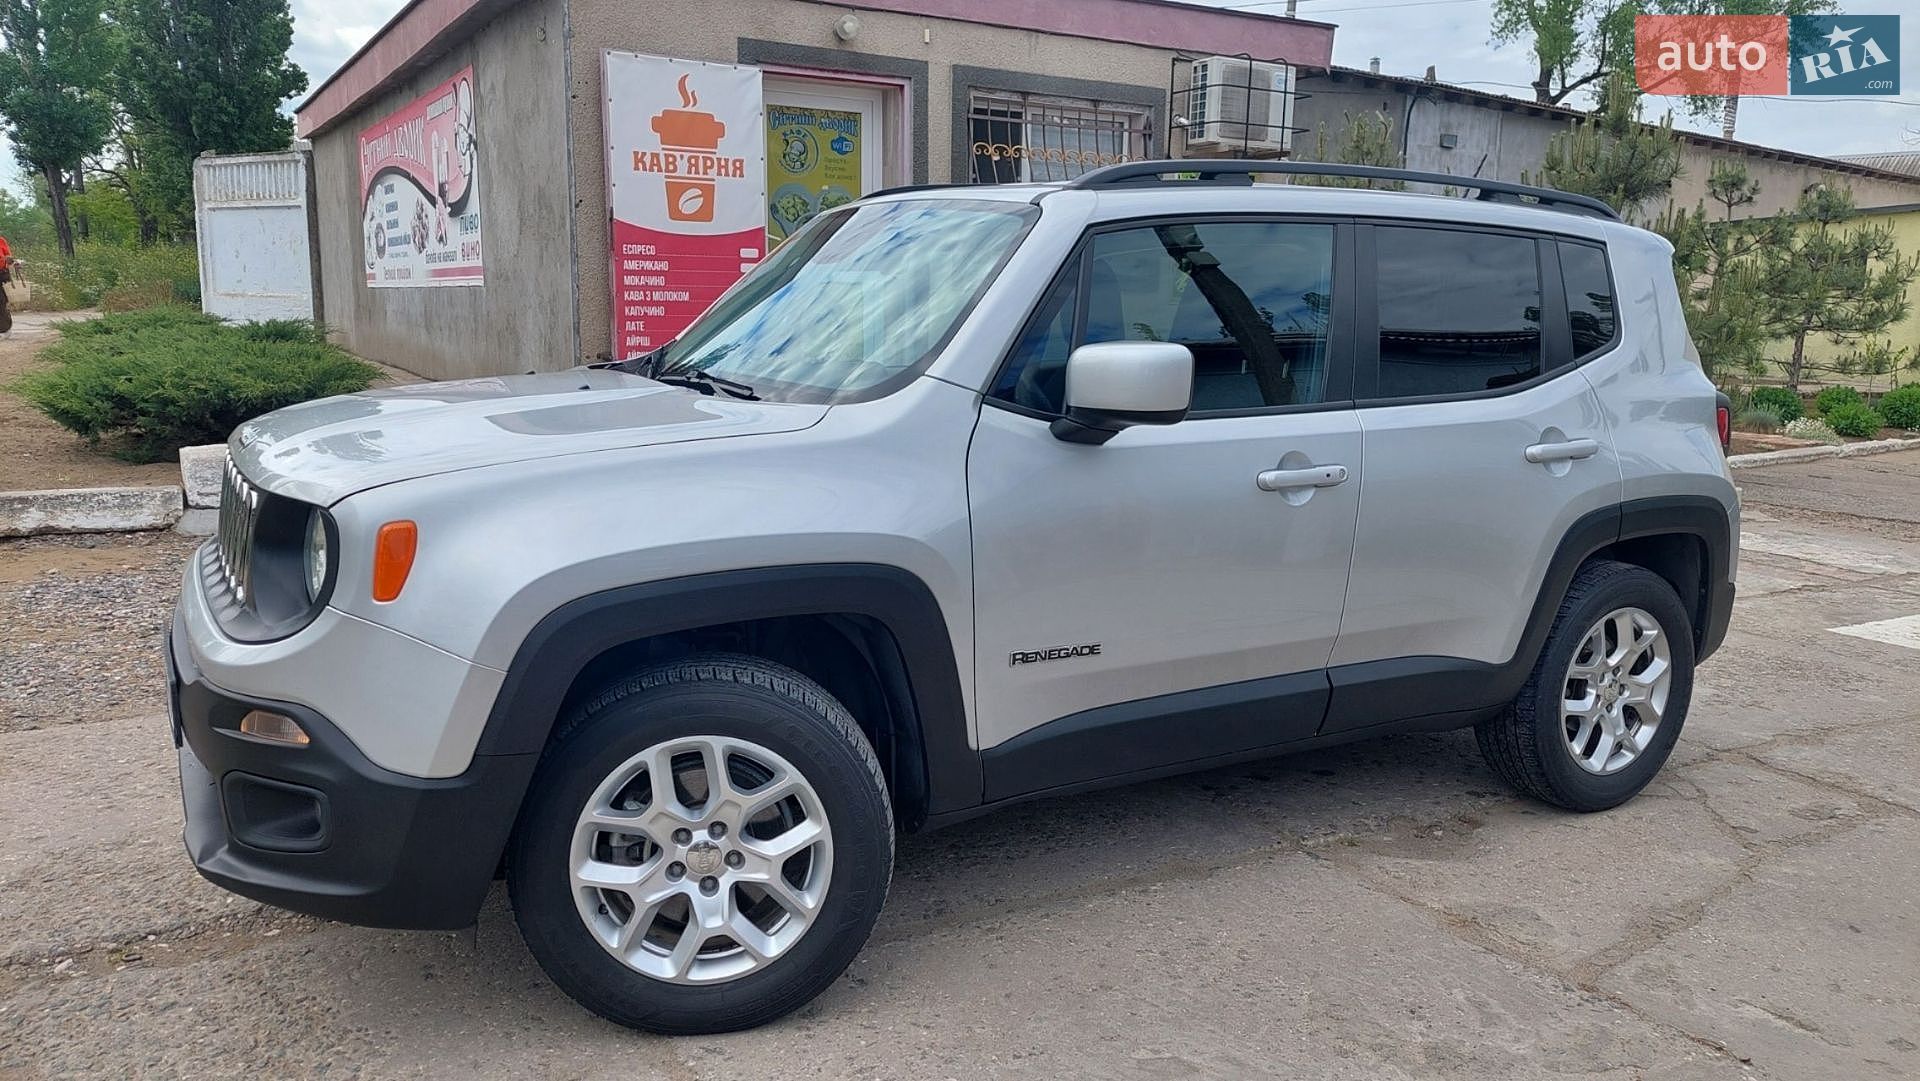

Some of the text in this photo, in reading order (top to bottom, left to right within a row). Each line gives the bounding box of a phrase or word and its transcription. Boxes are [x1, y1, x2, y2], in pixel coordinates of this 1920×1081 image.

[632, 150, 745, 178] КАВ'ЯРНЯ
[623, 244, 656, 255] ЕСПРЕСО
[623, 260, 669, 271] АМЕРИКАНО
[623, 275, 665, 286] МОКАЧИНО
[624, 291, 644, 301] КАВА
[653, 291, 689, 302] МОЛОКОМ
[625, 306, 665, 316] КАПУЧИНО
[626, 321, 645, 331] ЛАТЕ
[1010, 644, 1102, 666] RENEGADE
